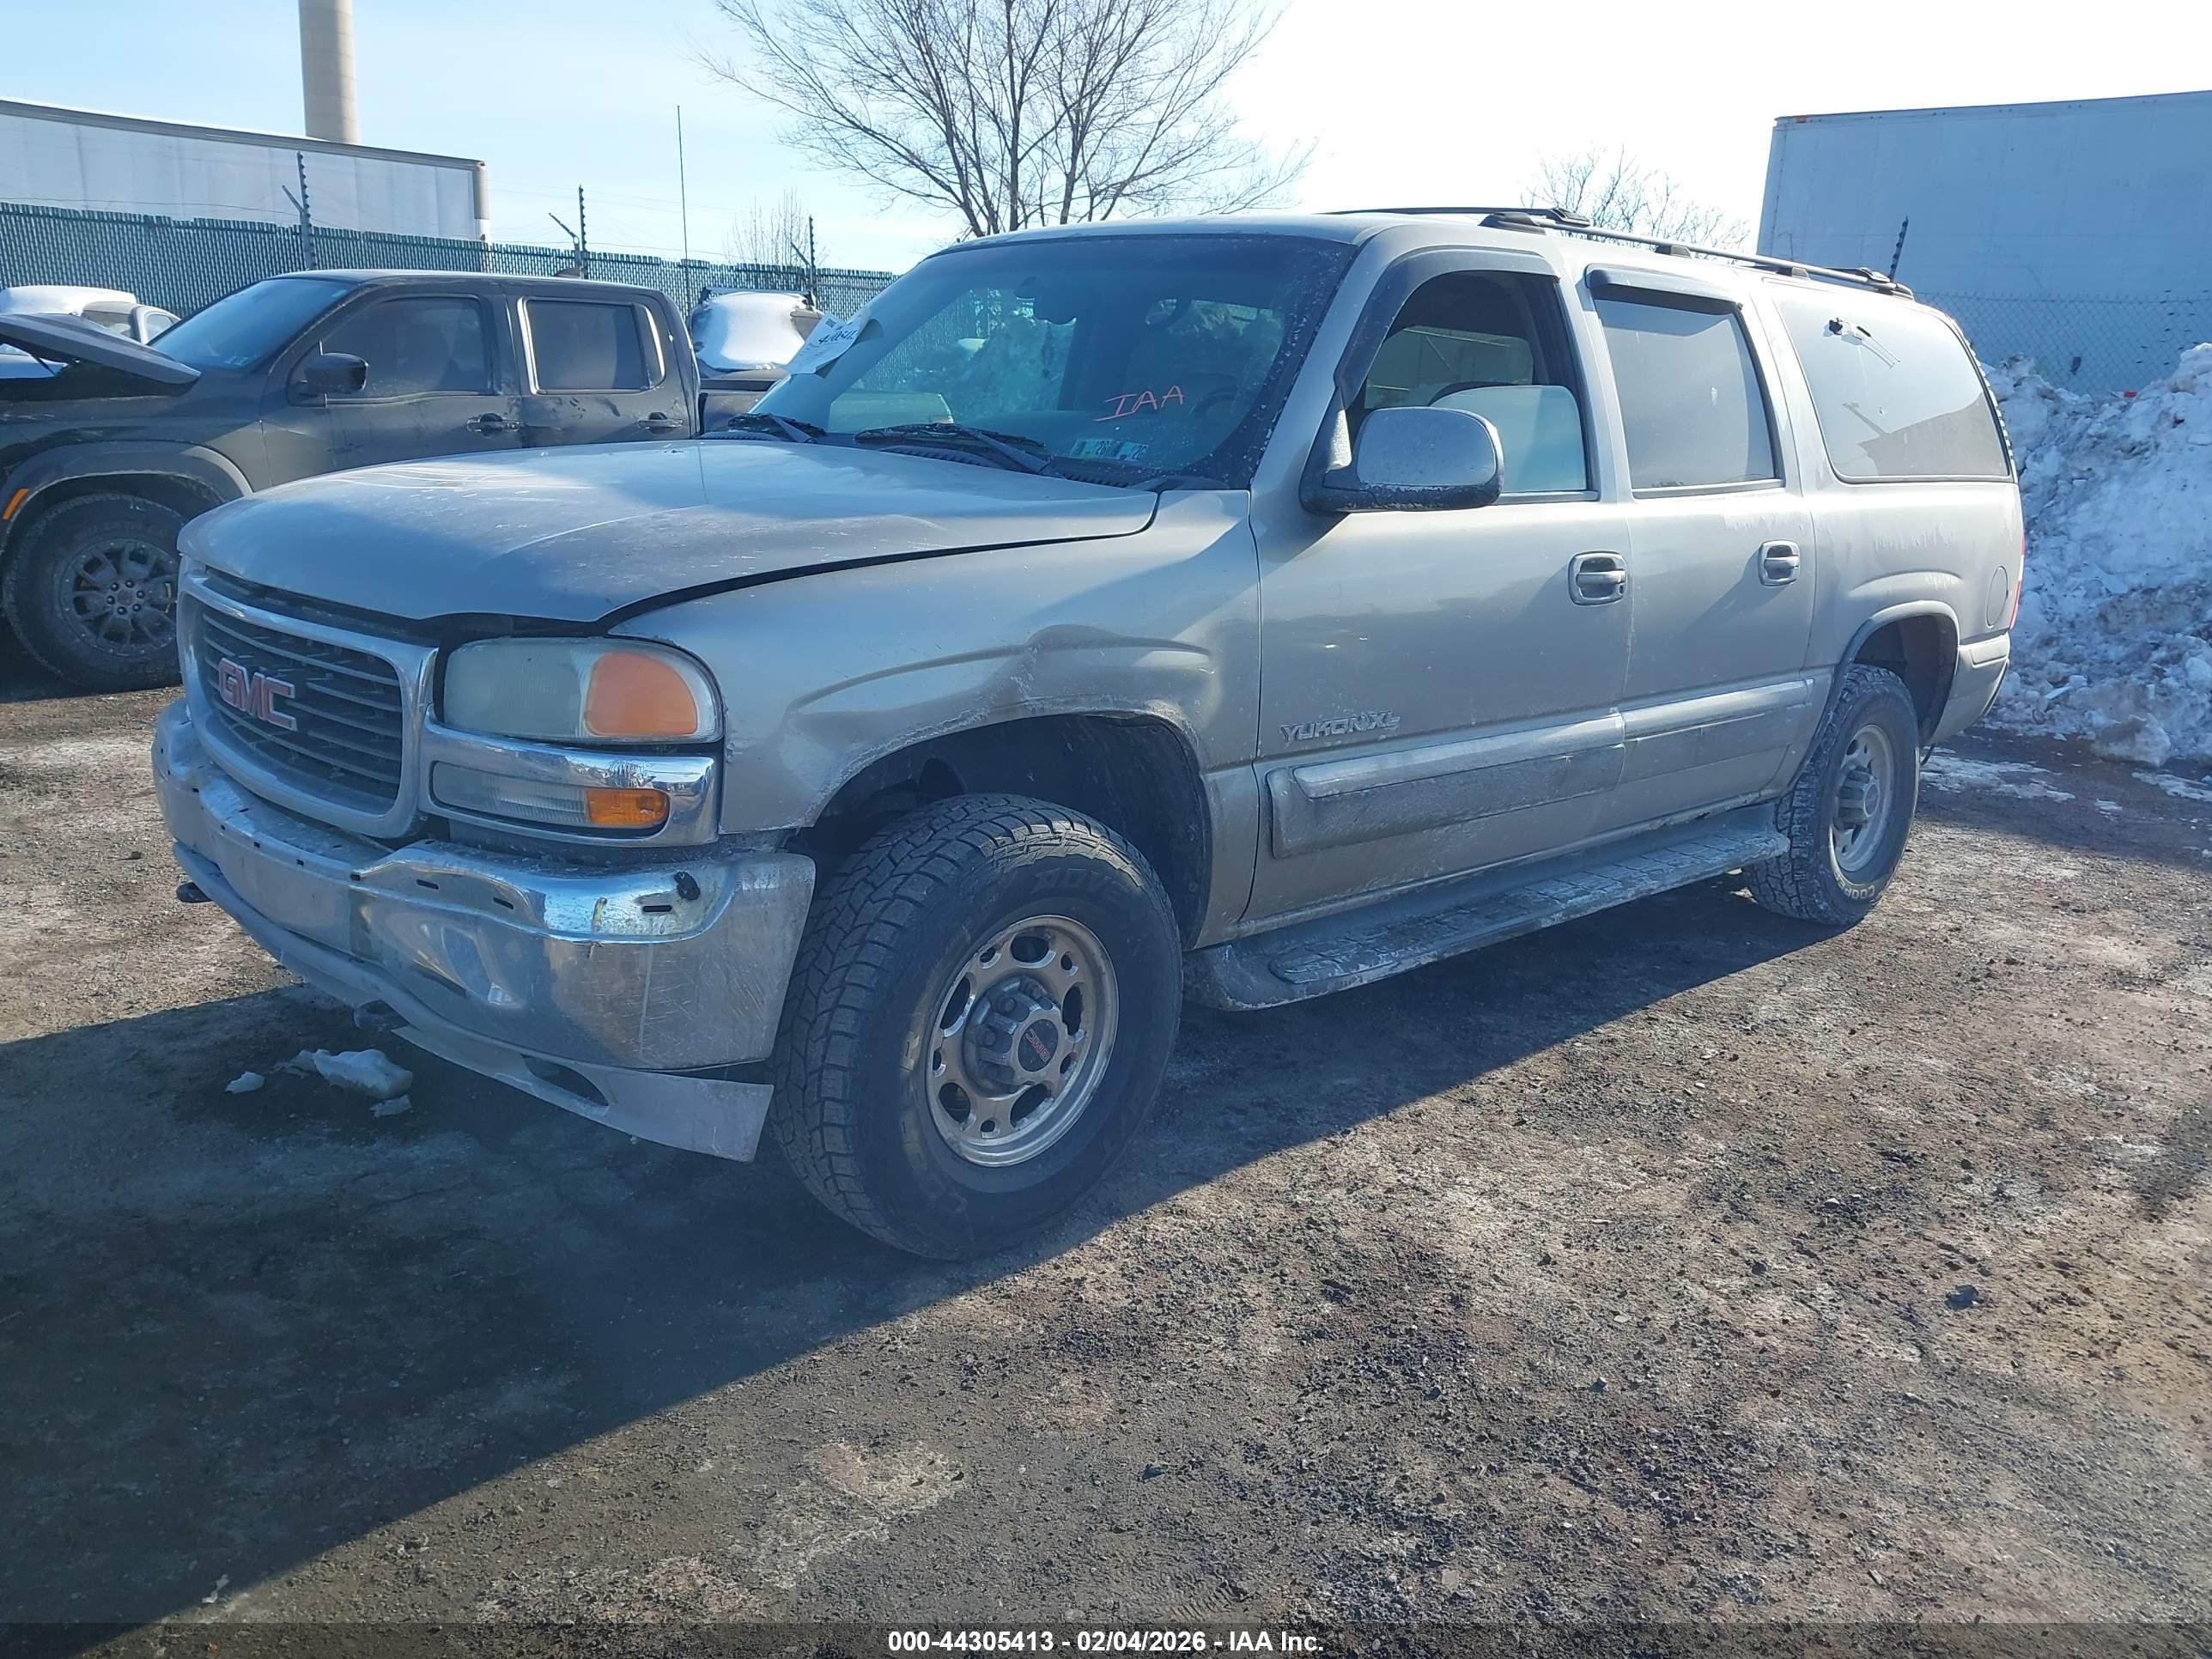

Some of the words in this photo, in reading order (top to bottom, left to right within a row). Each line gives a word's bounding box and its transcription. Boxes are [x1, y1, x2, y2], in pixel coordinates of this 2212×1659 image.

[1094, 386, 1184, 422] IAA
[218, 657, 297, 732] GMC
[1279, 714, 1367, 741] YUKON
[1024, 1026, 1051, 1063] GMC
